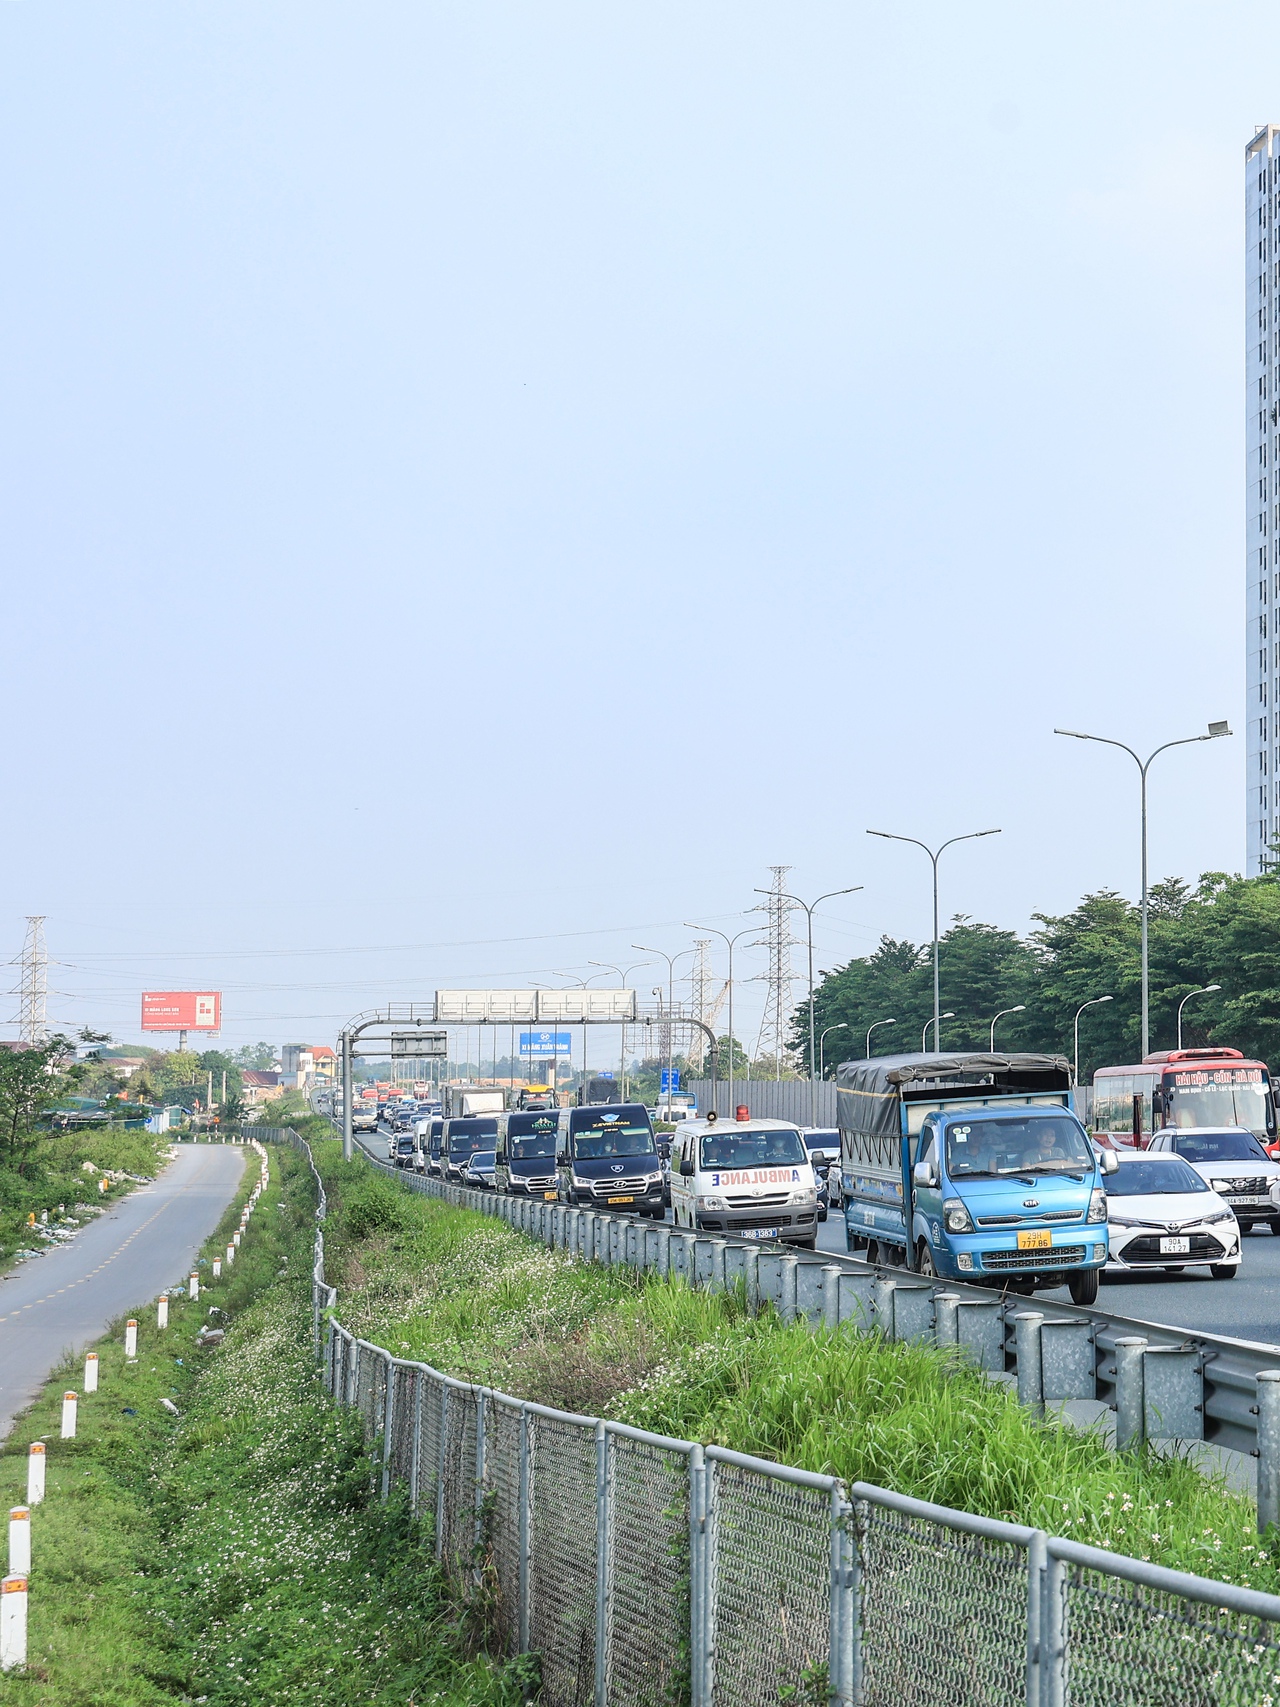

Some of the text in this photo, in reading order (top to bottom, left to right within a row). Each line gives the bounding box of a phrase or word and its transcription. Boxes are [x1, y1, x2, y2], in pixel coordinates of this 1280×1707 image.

[1175, 1071, 1191, 1086] HẢI
[1191, 1070, 1208, 1087] HẬU
[1235, 1068, 1247, 1083] HÀ
[1247, 1068, 1263, 1084] NỘI
[1027, 1232, 1042, 1240] 29H
[1022, 1239, 1048, 1248] 777.86
